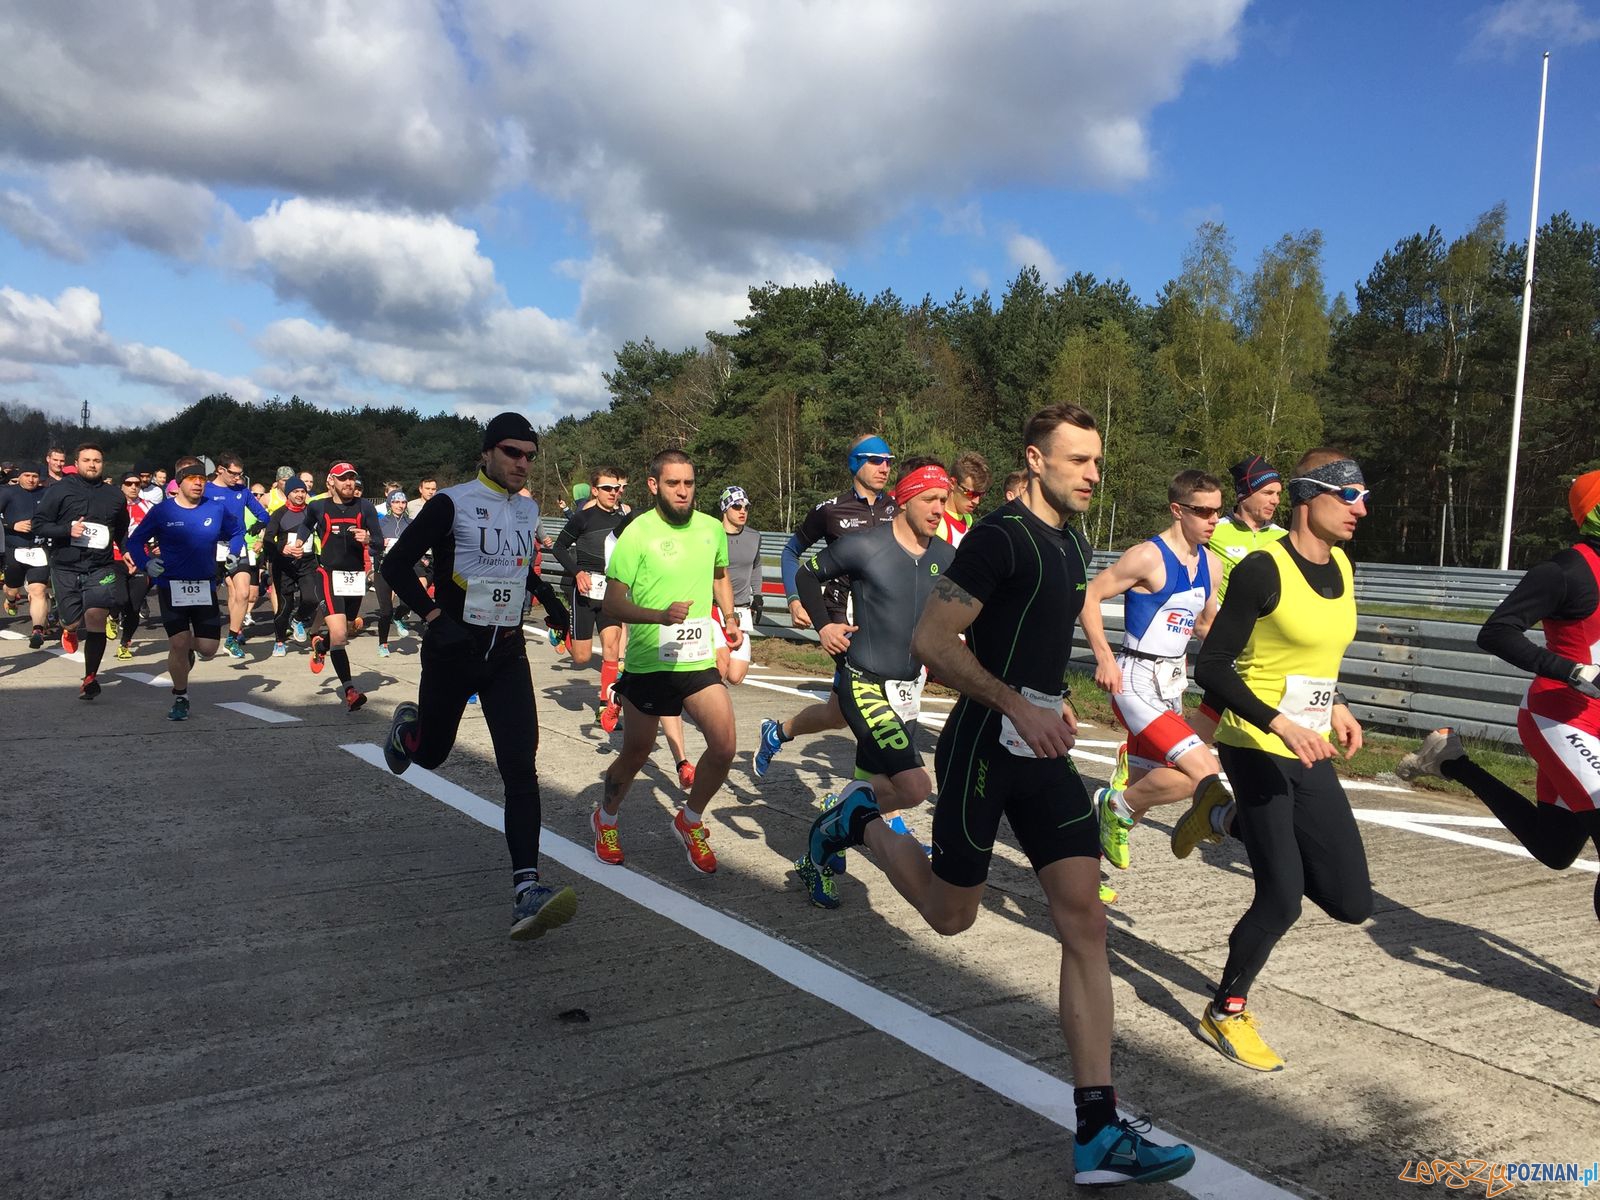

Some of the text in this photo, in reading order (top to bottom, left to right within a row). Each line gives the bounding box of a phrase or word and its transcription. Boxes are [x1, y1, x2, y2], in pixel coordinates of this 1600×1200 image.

[478, 526, 534, 556] UAM
[478, 555, 516, 567] Triathlon
[343, 576, 355, 584] 35
[180, 585, 201, 594] 103
[492, 588, 511, 603] 85
[676, 627, 703, 640] 220
[1309, 690, 1331, 706] 39
[852, 680, 910, 750] KAMP
